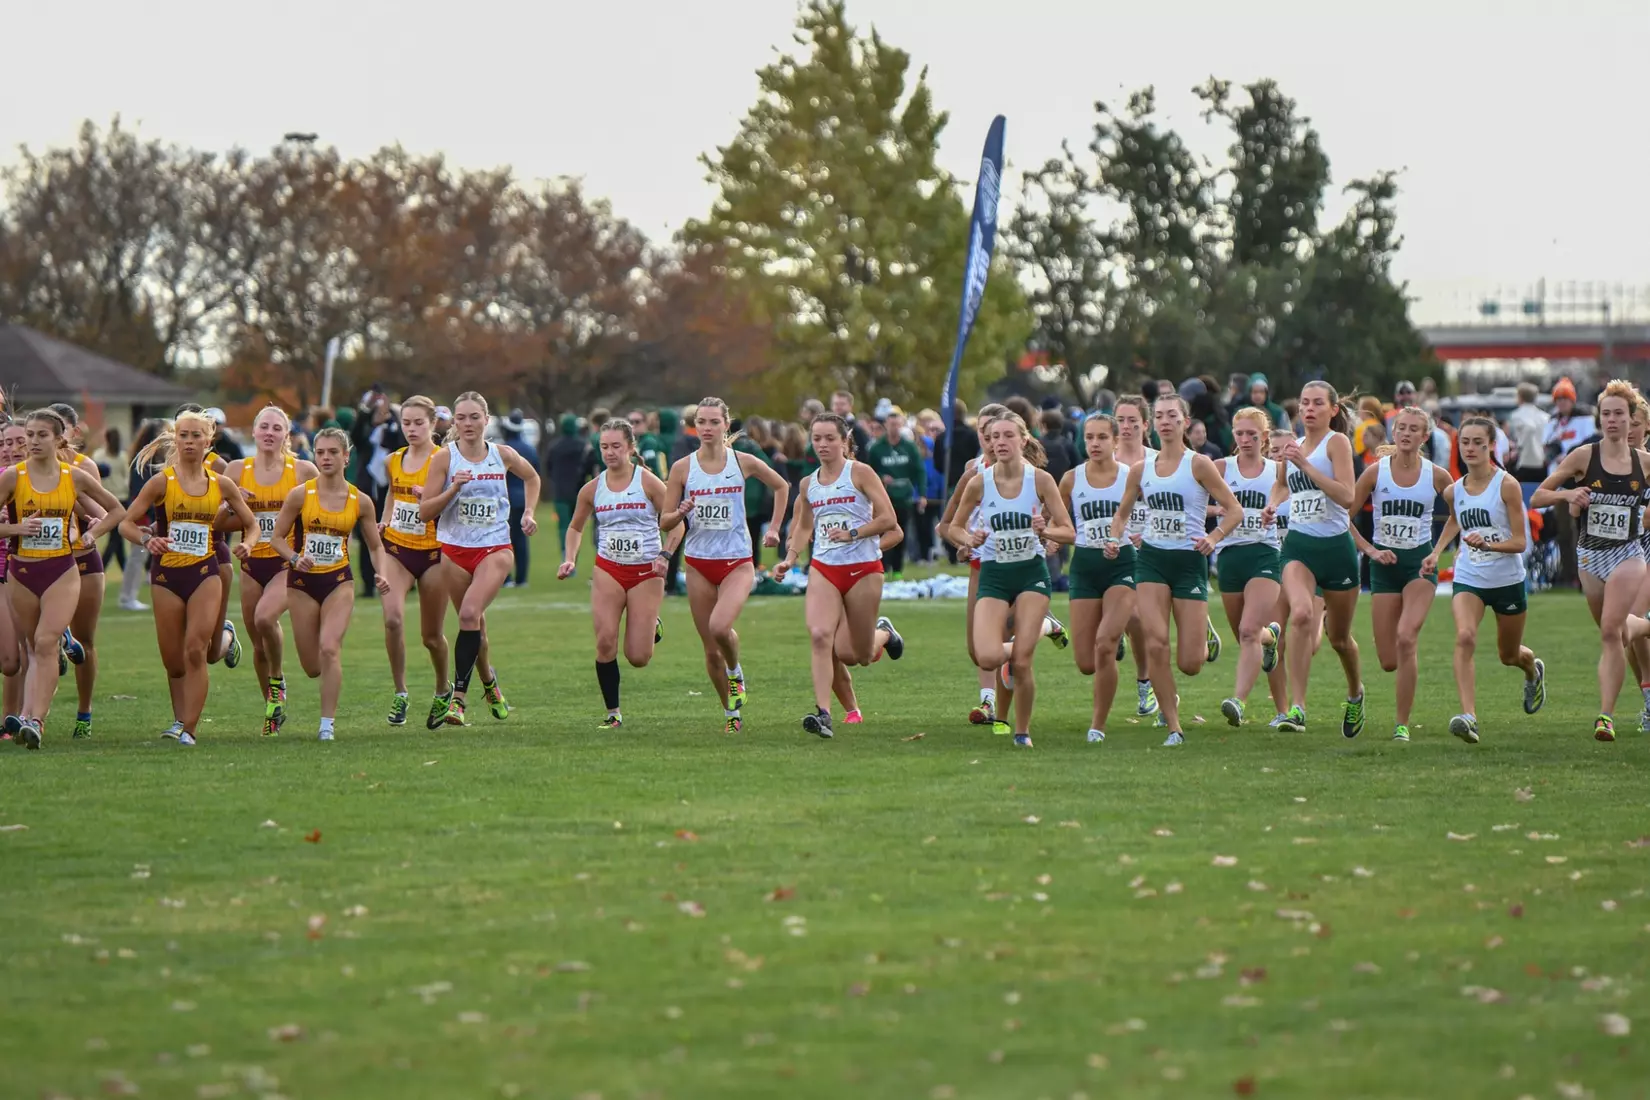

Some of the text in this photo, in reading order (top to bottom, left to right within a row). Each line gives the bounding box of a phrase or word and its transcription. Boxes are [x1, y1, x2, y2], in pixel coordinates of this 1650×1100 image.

[477, 473, 504, 481] STATE
[689, 486, 743, 497] BALL STATE
[615, 502, 647, 511] STATE
[811, 496, 856, 508] ALL STATE
[1147, 491, 1185, 512] OHIO
[1293, 498, 1323, 514] 3172
[1382, 499, 1425, 519] OHIO
[462, 503, 491, 518] 3031
[697, 504, 729, 519] 3020
[1130, 508, 1146, 522] 69
[259, 518, 277, 532] 08
[991, 511, 1033, 532] OHIO
[1153, 516, 1182, 532] 3178
[1239, 516, 1263, 529] 165
[1460, 508, 1492, 531] OHIO
[1592, 511, 1626, 528] 3218
[27, 525, 59, 539] 92
[173, 529, 203, 545] 3091
[1089, 525, 1111, 540] 316
[1384, 523, 1414, 539] 3171
[309, 540, 339, 556] 3097
[610, 537, 639, 552] 3034
[999, 536, 1030, 552] 3167
